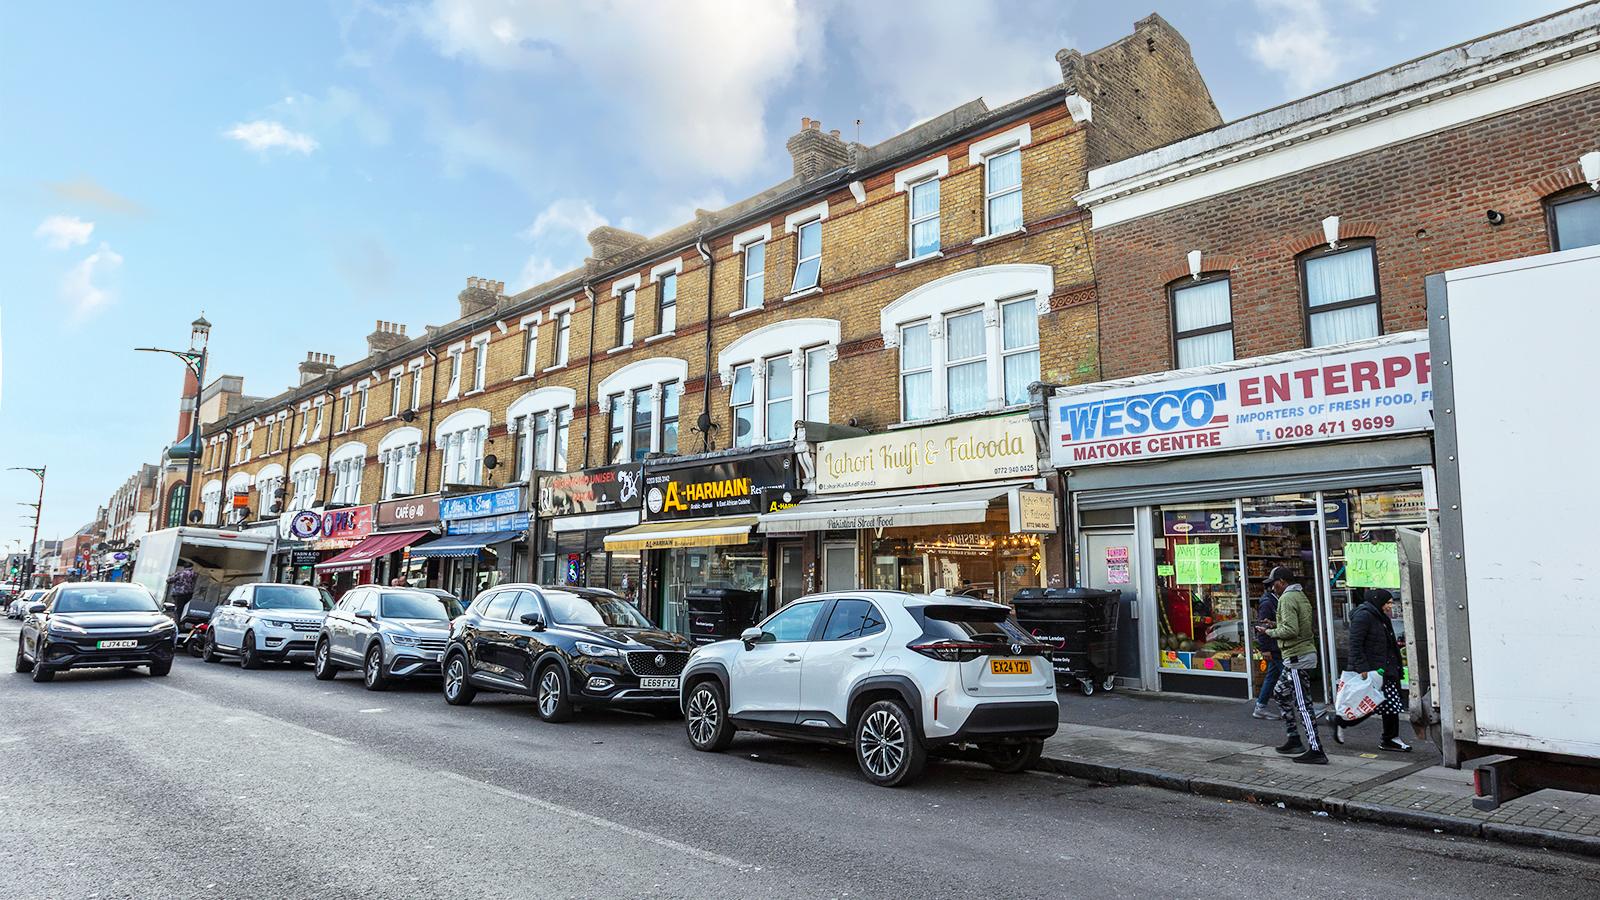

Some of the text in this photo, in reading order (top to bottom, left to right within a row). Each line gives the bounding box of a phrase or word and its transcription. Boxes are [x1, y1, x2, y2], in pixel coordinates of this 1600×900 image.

[1065, 389, 1218, 441] WESCO
[1236, 406, 1304, 424] IMPORTERS
[1308, 404, 1325, 416] OF
[1329, 397, 1371, 414] FRESH
[1375, 392, 1417, 407] FOOD,
[1256, 415, 1394, 441] T: 0208 471 9699
[1073, 431, 1222, 461] MATOKE CENTRE
[825, 431, 1024, 479] Lahori Kulfi & Falooda
[590, 471, 616, 484] UNISEX
[994, 467, 1008, 475] 0772
[1020, 464, 1034, 473] 0425
[395, 503, 409, 519] CAFÉ
[416, 504, 424, 518] 48
[827, 515, 894, 529] Pakistani Street Food
[994, 662, 1029, 672] EX24 YZD
[643, 679, 676, 687] LE69 FYZ
